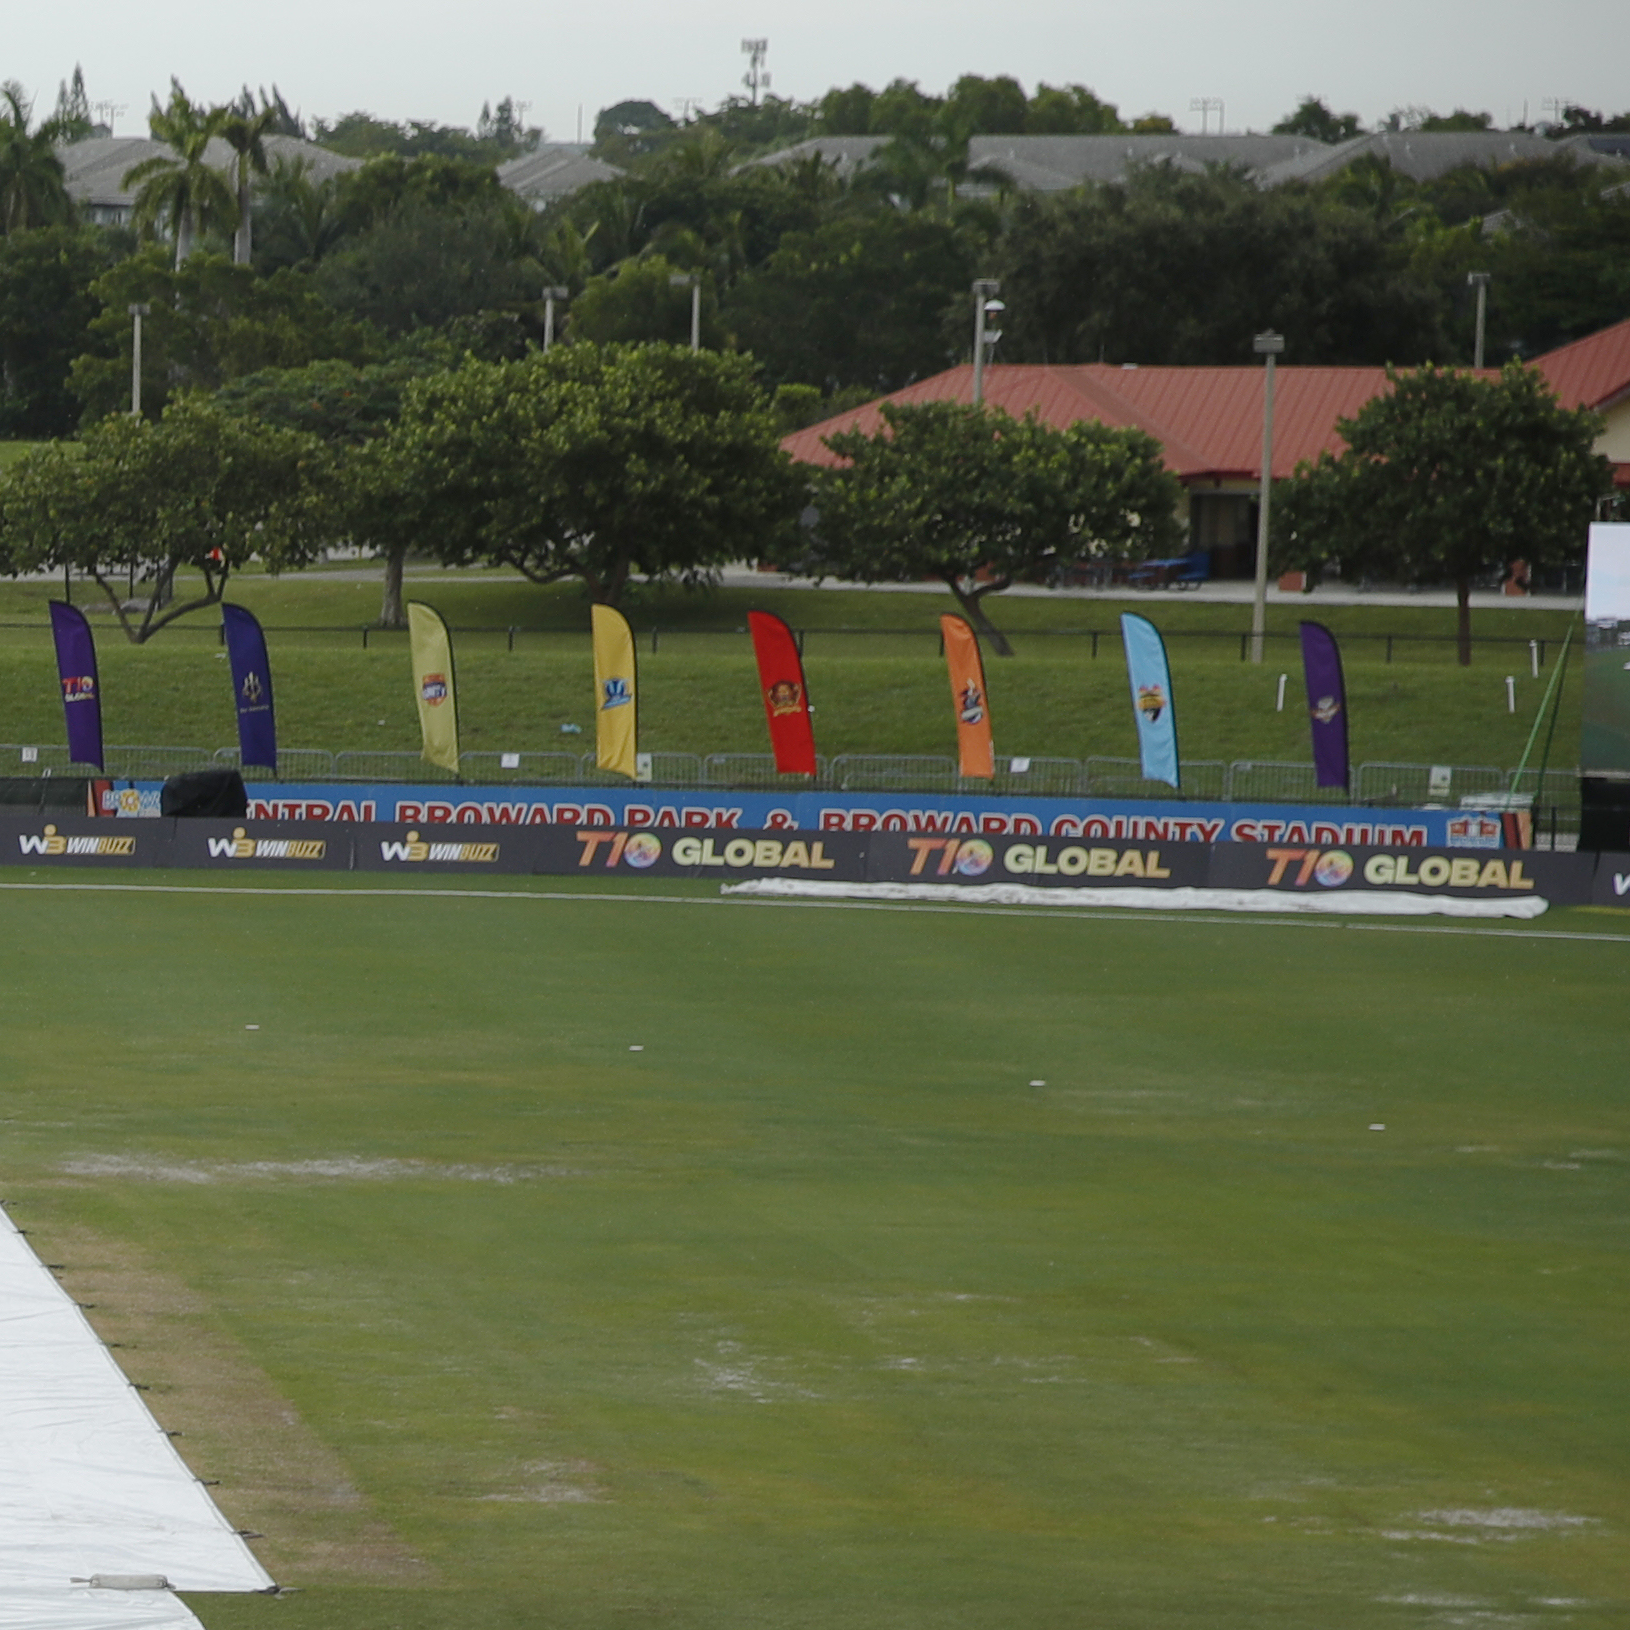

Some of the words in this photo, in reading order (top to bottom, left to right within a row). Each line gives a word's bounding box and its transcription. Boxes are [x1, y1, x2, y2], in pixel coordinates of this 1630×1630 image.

[395, 802, 616, 825] BROWARD
[624, 804, 743, 829] PARK
[819, 809, 1043, 836] BROWARD
[1050, 814, 1225, 842] COUNTY
[1231, 818, 1428, 847] STADIUM
[66, 837, 133, 855] WINBUZZ
[256, 839, 324, 858] WINBUZZ
[429, 843, 497, 862] WINBUZZ
[671, 838, 835, 869] GLOBAL
[1004, 844, 1171, 878] GLOBAL
[1364, 855, 1534, 889] GLOBAL
